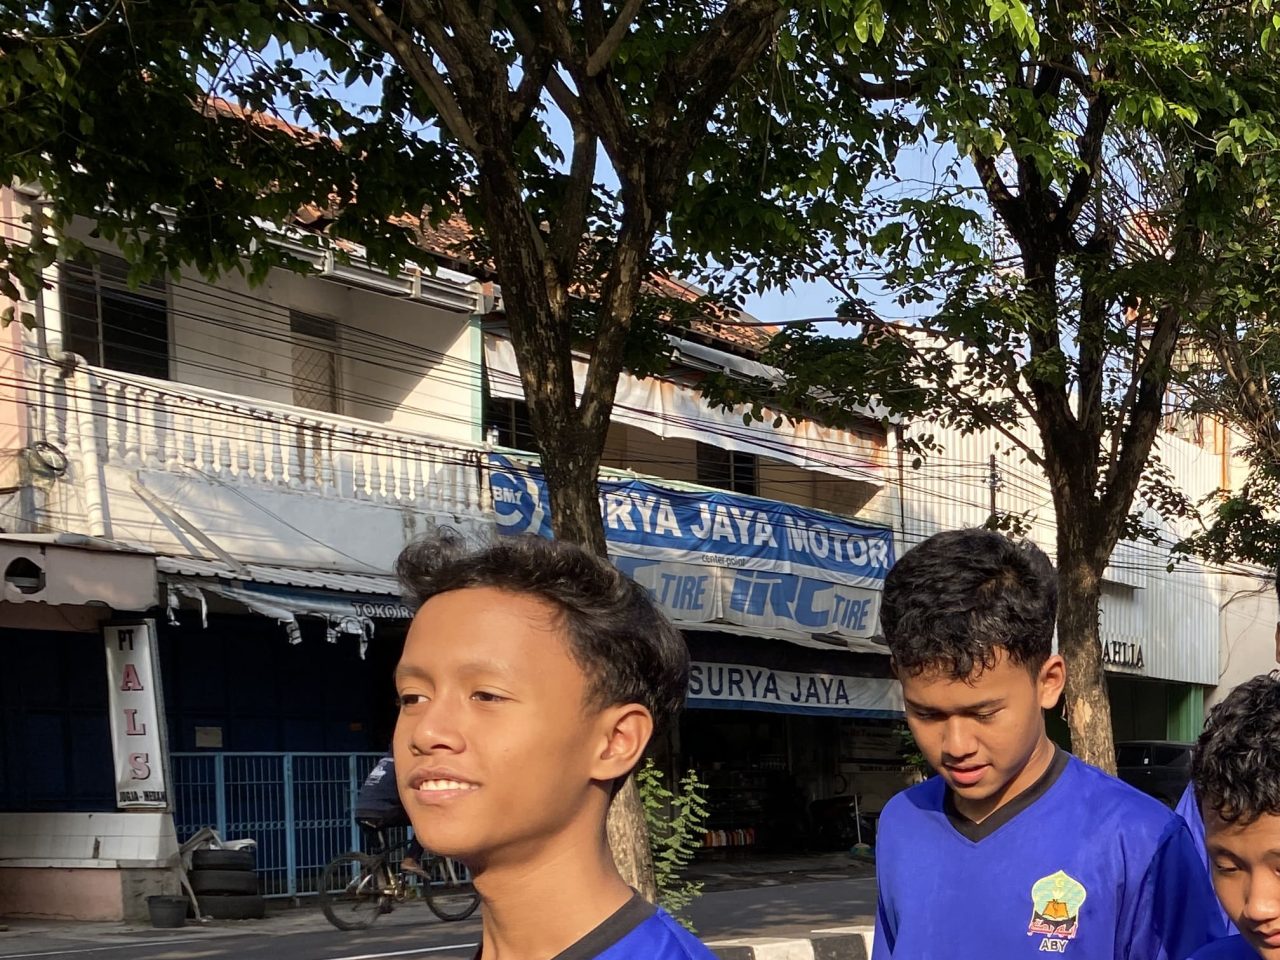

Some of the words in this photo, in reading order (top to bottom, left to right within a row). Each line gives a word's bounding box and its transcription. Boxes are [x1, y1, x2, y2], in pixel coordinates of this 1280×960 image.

[598, 491, 683, 537] RYA
[690, 502, 778, 548] JAYA
[786, 515, 889, 570] MOTOR
[660, 573, 708, 610] TIRE
[832, 593, 872, 631] TIRE
[117, 629, 135, 651] PT
[1102, 639, 1145, 668] AHLIA
[688, 665, 781, 700] SURYA
[790, 676, 850, 705] JAYA
[120, 664, 151, 780] ALS
[1039, 937, 1069, 953] ABY
